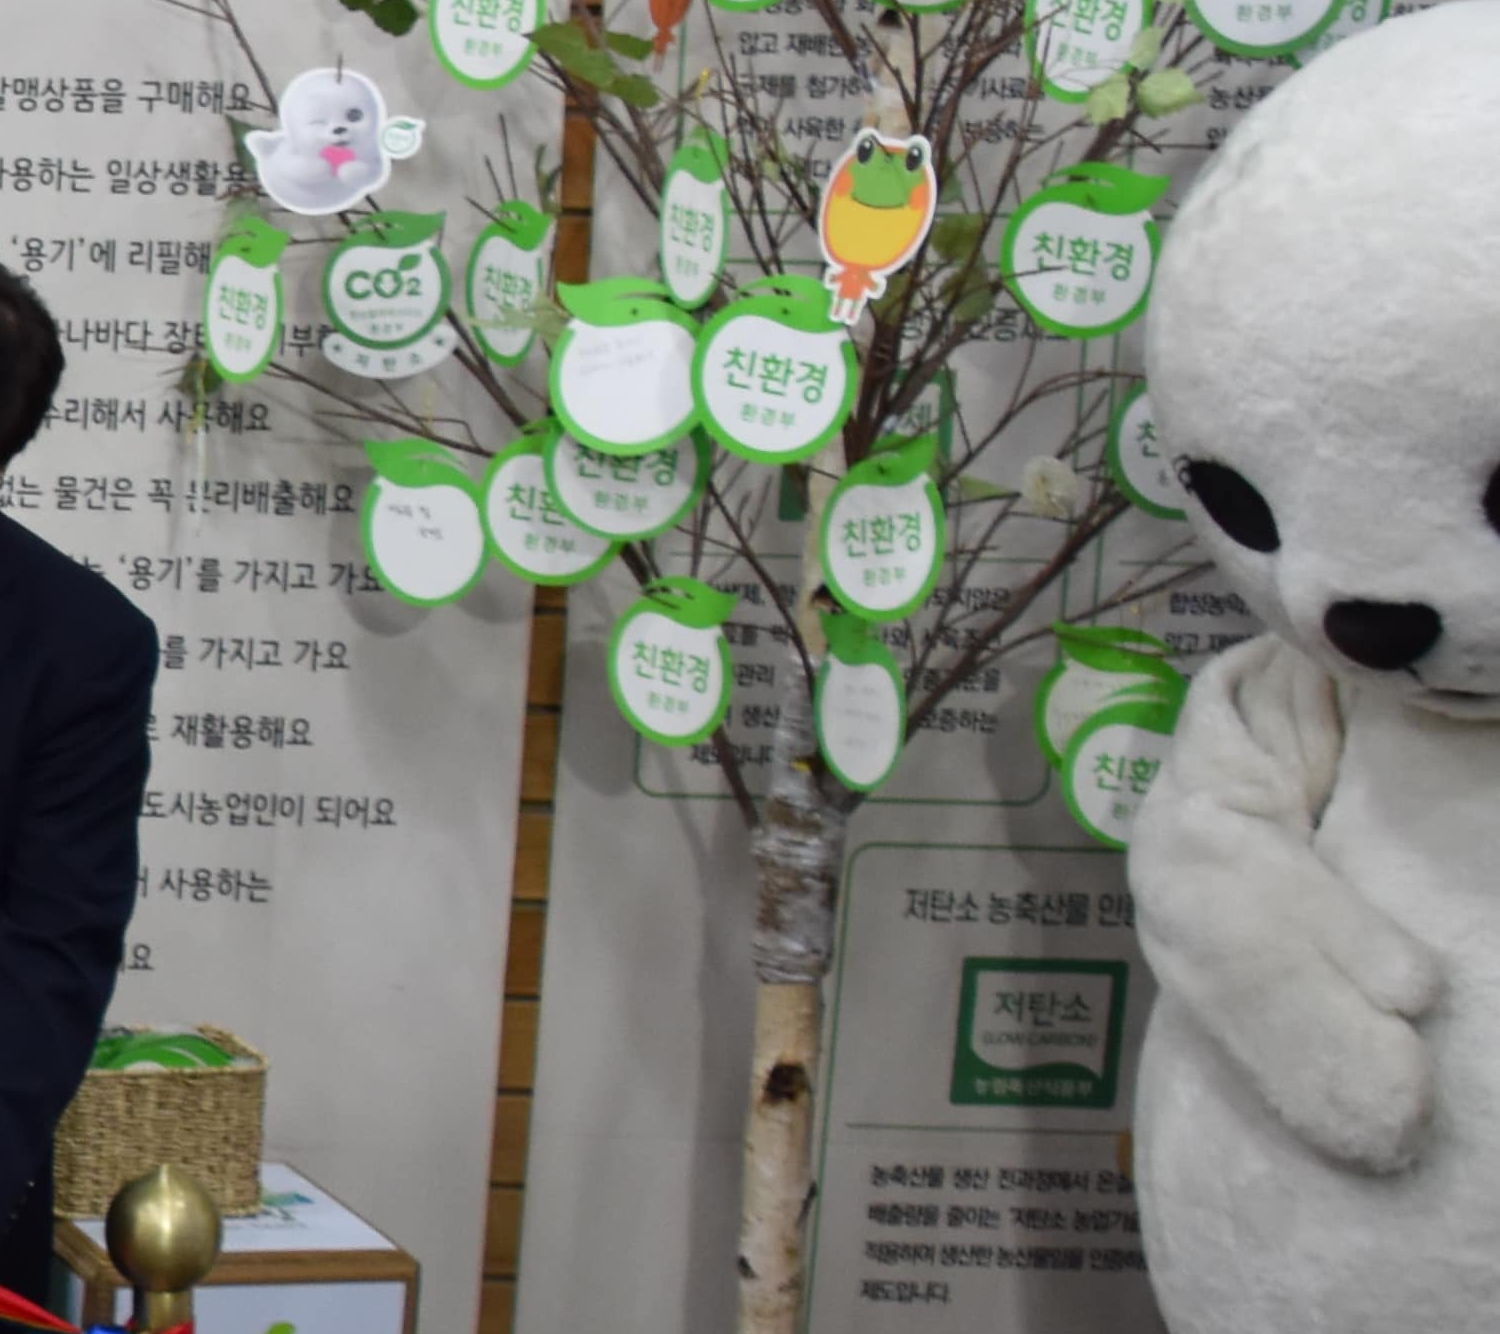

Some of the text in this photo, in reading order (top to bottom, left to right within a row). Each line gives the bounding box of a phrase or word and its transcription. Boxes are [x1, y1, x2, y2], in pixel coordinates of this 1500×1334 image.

[1236, 3, 1293, 22] 환경부
[137, 79, 254, 116] 구매해요
[106, 156, 268, 197] 일상생활용
[668, 204, 718, 254] 친환경
[128, 240, 212, 276] 리필해
[1033, 230, 1137, 285] 친환경
[344, 267, 424, 301] CO2
[1050, 283, 1108, 307] 환경부
[216, 283, 269, 332] 친환경
[57, 319, 151, 351] 나바다
[724, 346, 830, 406] 친환경
[157, 398, 273, 434] 사용해요
[739, 403, 798, 430] 환경부
[571, 438, 681, 491] 친환경
[53, 475, 137, 513] 물건은
[147, 477, 176, 513] 꼭
[185, 478, 357, 517] 분리배출해요
[505, 480, 566, 529] 친환
[593, 489, 650, 515] 환경부
[841, 512, 923, 557] 친환경
[232, 559, 318, 595] 가지고
[327, 563, 386, 596] 가요
[198, 636, 283, 671] 가지고
[293, 640, 352, 673] 가요
[630, 639, 712, 697] 친환경
[170, 713, 314, 750] 재활용해요
[1093, 751, 1163, 796] 친환
[141, 790, 397, 829] 도시농업인이 되어요
[159, 867, 273, 903] 사용하는
[904, 887, 981, 923] 저탄소
[987, 891, 1090, 927] 농축산물
[994, 991, 1093, 1028] 저탄소
[870, 1164, 945, 1189] 농축산물
[953, 1169, 990, 1191] 생산
[946, 1204, 1001, 1230] 줄이는
[941, 1242, 994, 1268] 생산한
